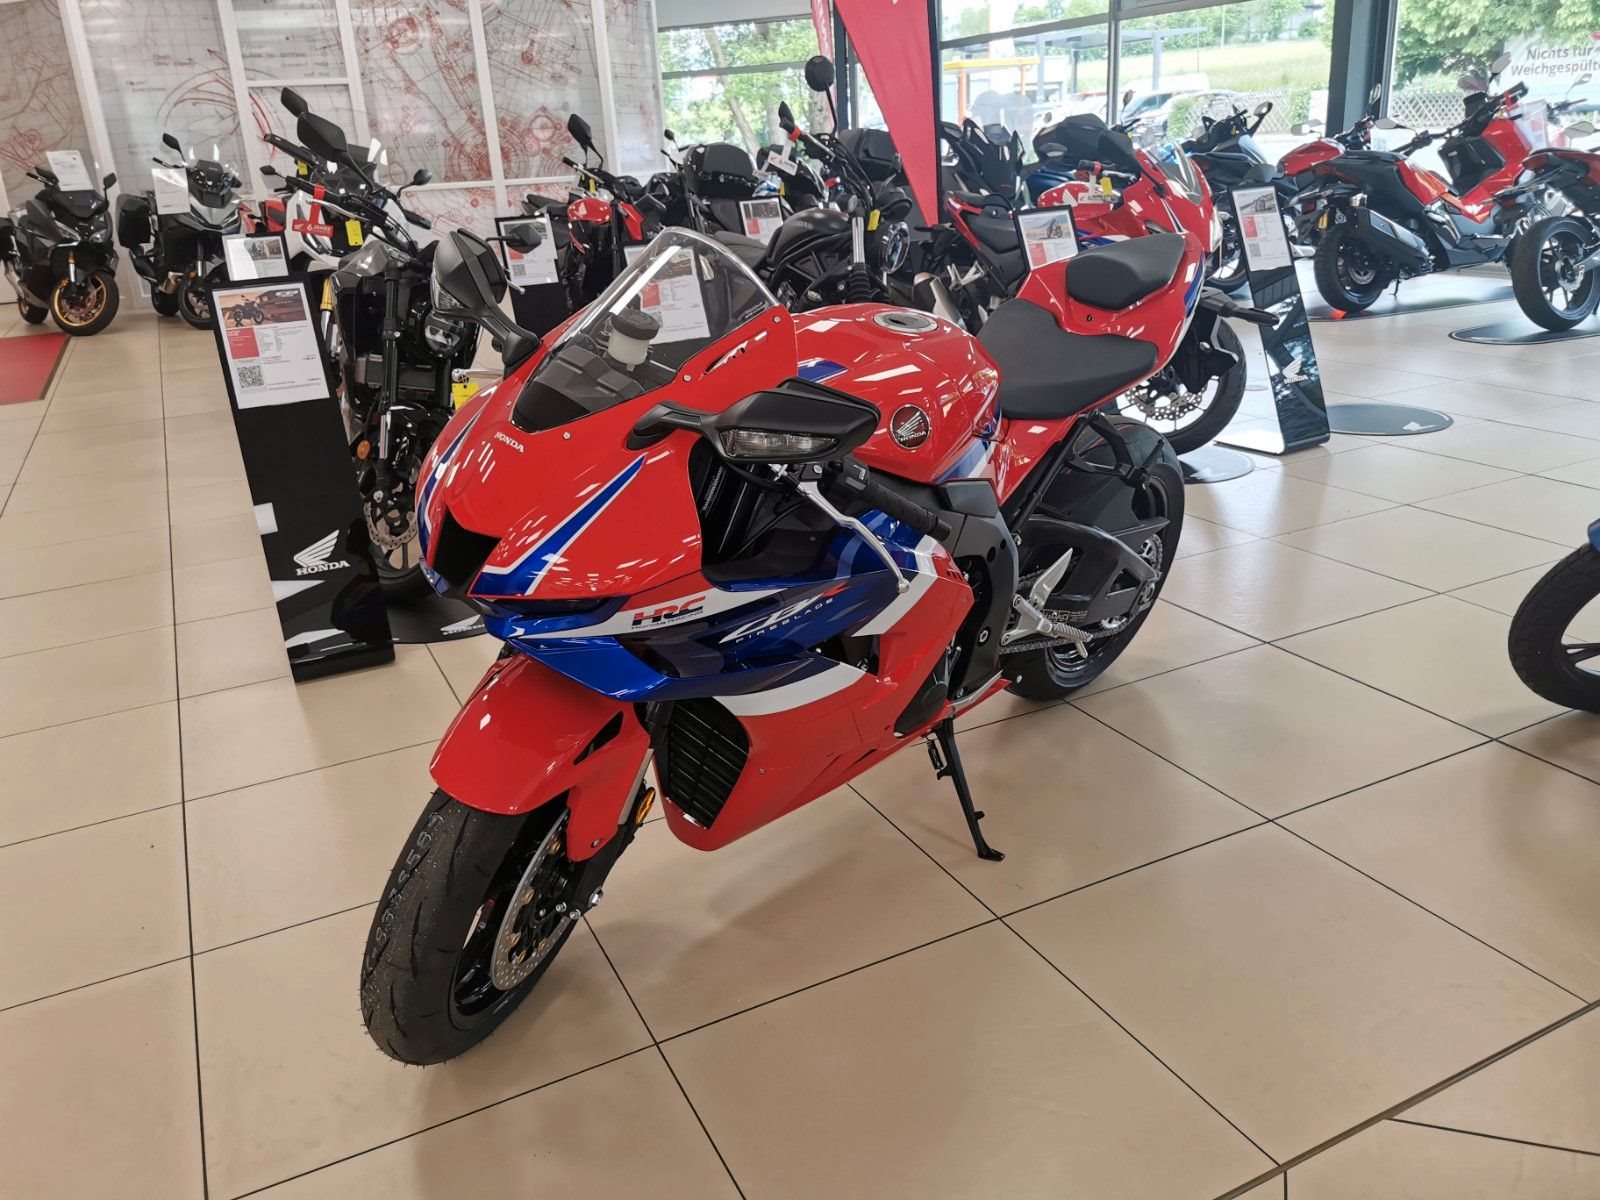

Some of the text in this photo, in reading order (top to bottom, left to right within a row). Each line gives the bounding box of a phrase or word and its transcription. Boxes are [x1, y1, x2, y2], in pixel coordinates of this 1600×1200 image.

[1511, 59, 1600, 76] Weichgespült
[494, 431, 525, 453] HONDA
[296, 560, 351, 576] HONDA
[632, 595, 706, 626] HRC
[735, 597, 834, 643] FIREBLADE
